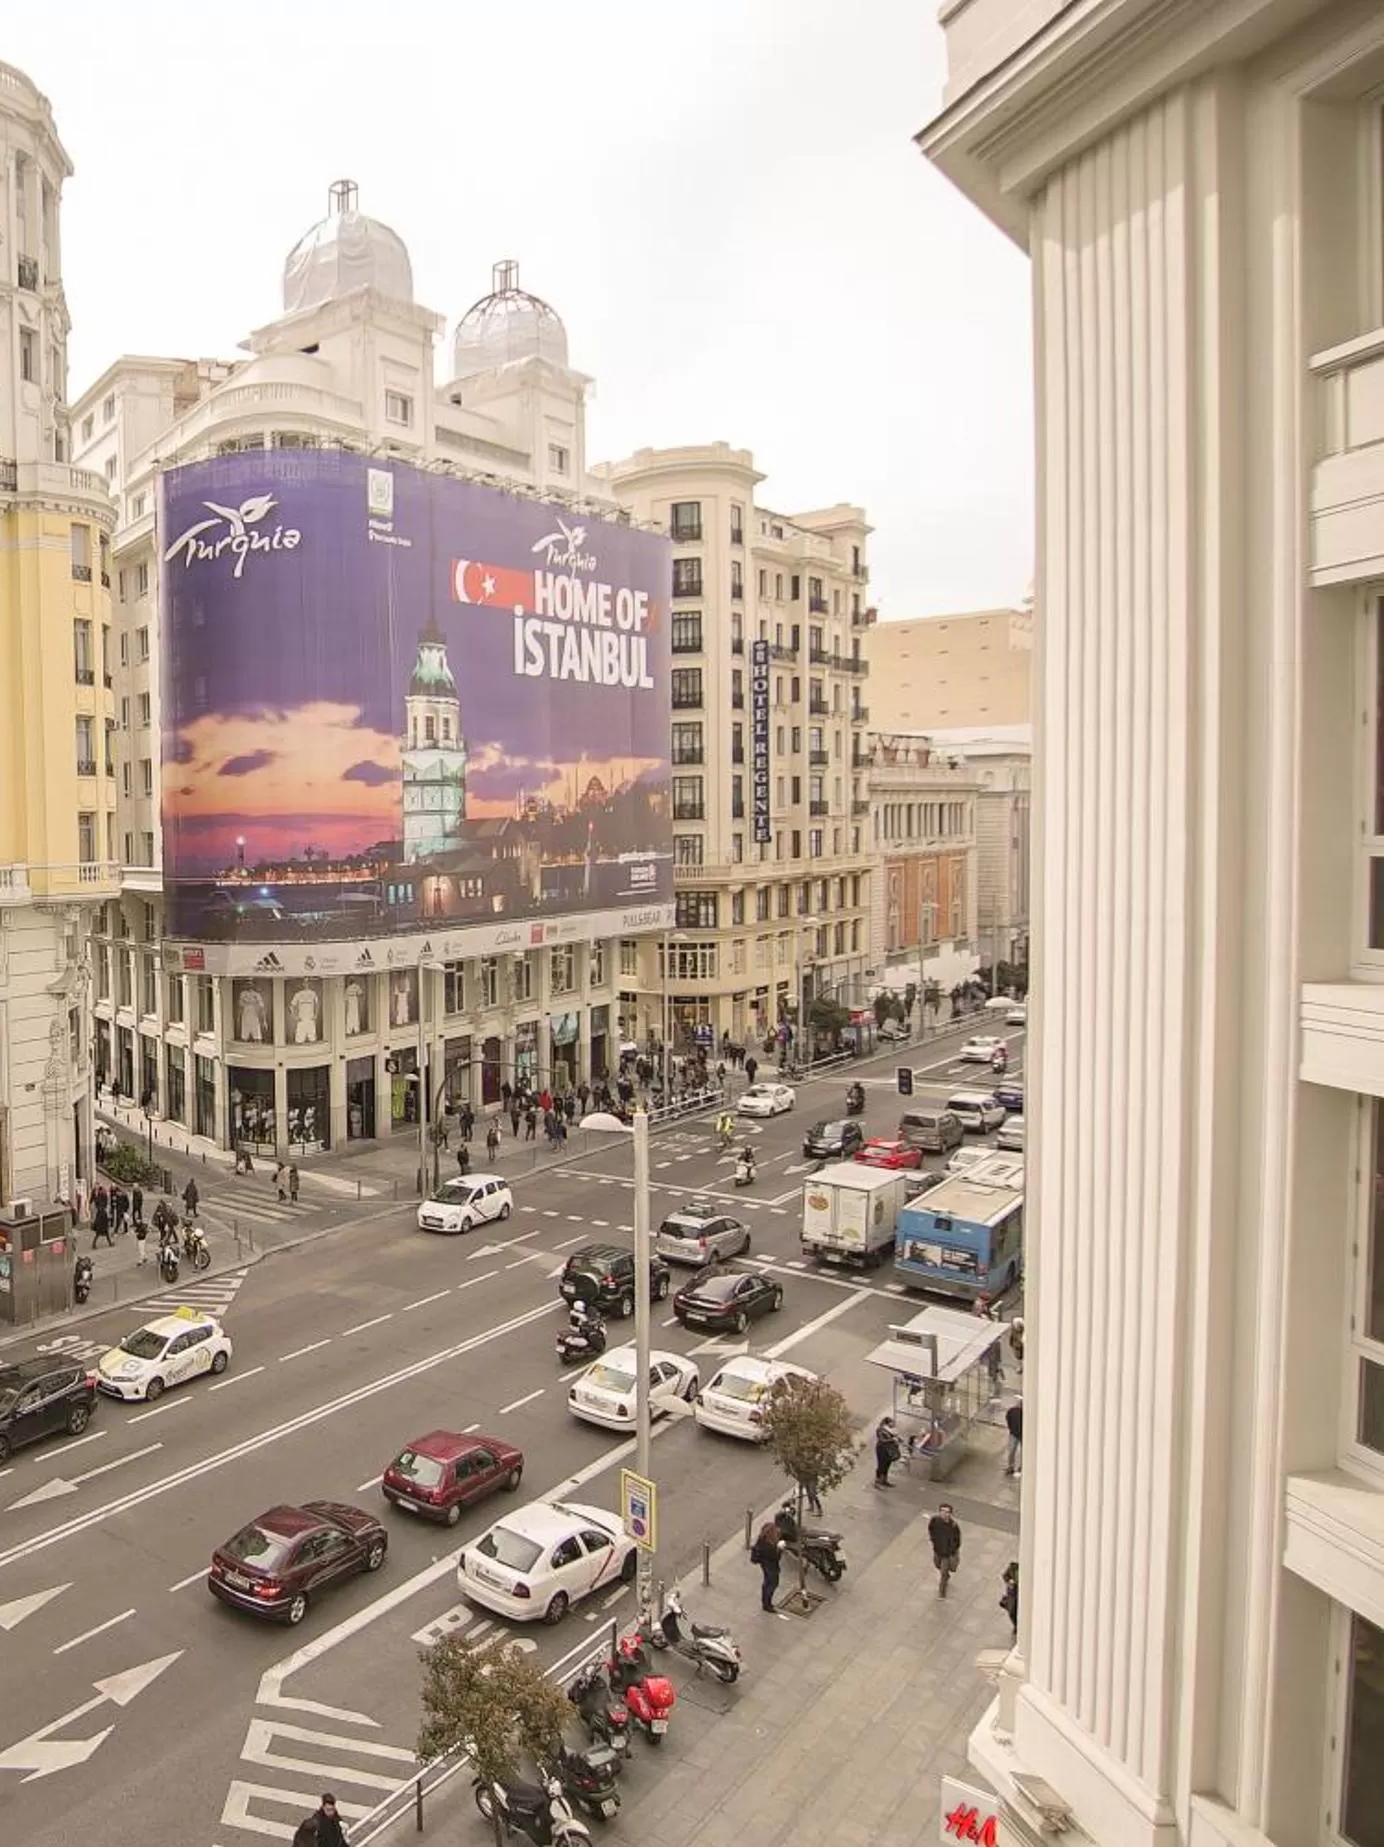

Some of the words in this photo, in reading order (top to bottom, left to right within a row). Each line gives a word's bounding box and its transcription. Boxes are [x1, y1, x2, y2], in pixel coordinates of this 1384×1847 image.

[534, 570, 612, 627] HOME
[617, 588, 649, 632] OF
[754, 664, 767, 735] HOTEL
[754, 742, 767, 841] REGENTE
